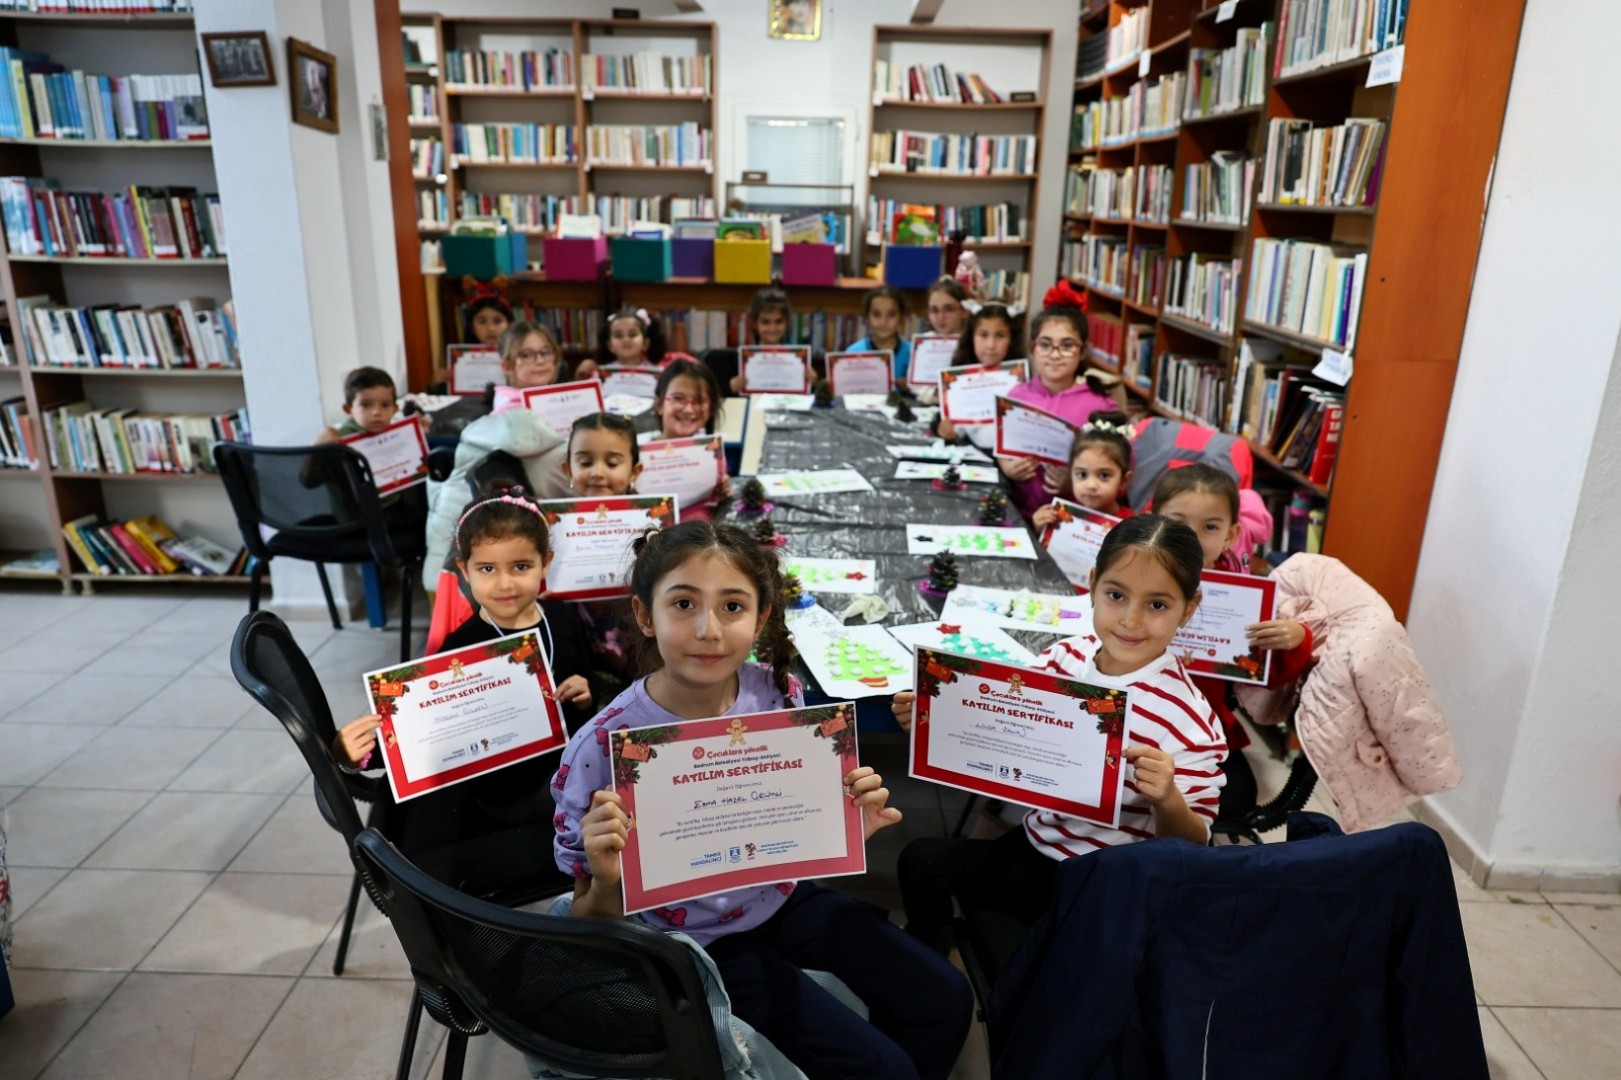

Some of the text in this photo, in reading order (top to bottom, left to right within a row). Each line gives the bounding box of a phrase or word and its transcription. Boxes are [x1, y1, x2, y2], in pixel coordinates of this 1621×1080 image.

[419, 693, 457, 709] KATILIM
[458, 677, 512, 698] SERTİFİKASI
[990, 690, 1043, 706] Çocuklara yönelik
[962, 698, 1074, 729] KATILIM SERTİFİKASI
[706, 745, 768, 760] Çocuklara yönelik
[672, 758, 803, 786] KATILIM SERTİFİKASI
[694, 761, 714, 769] Bodrum
